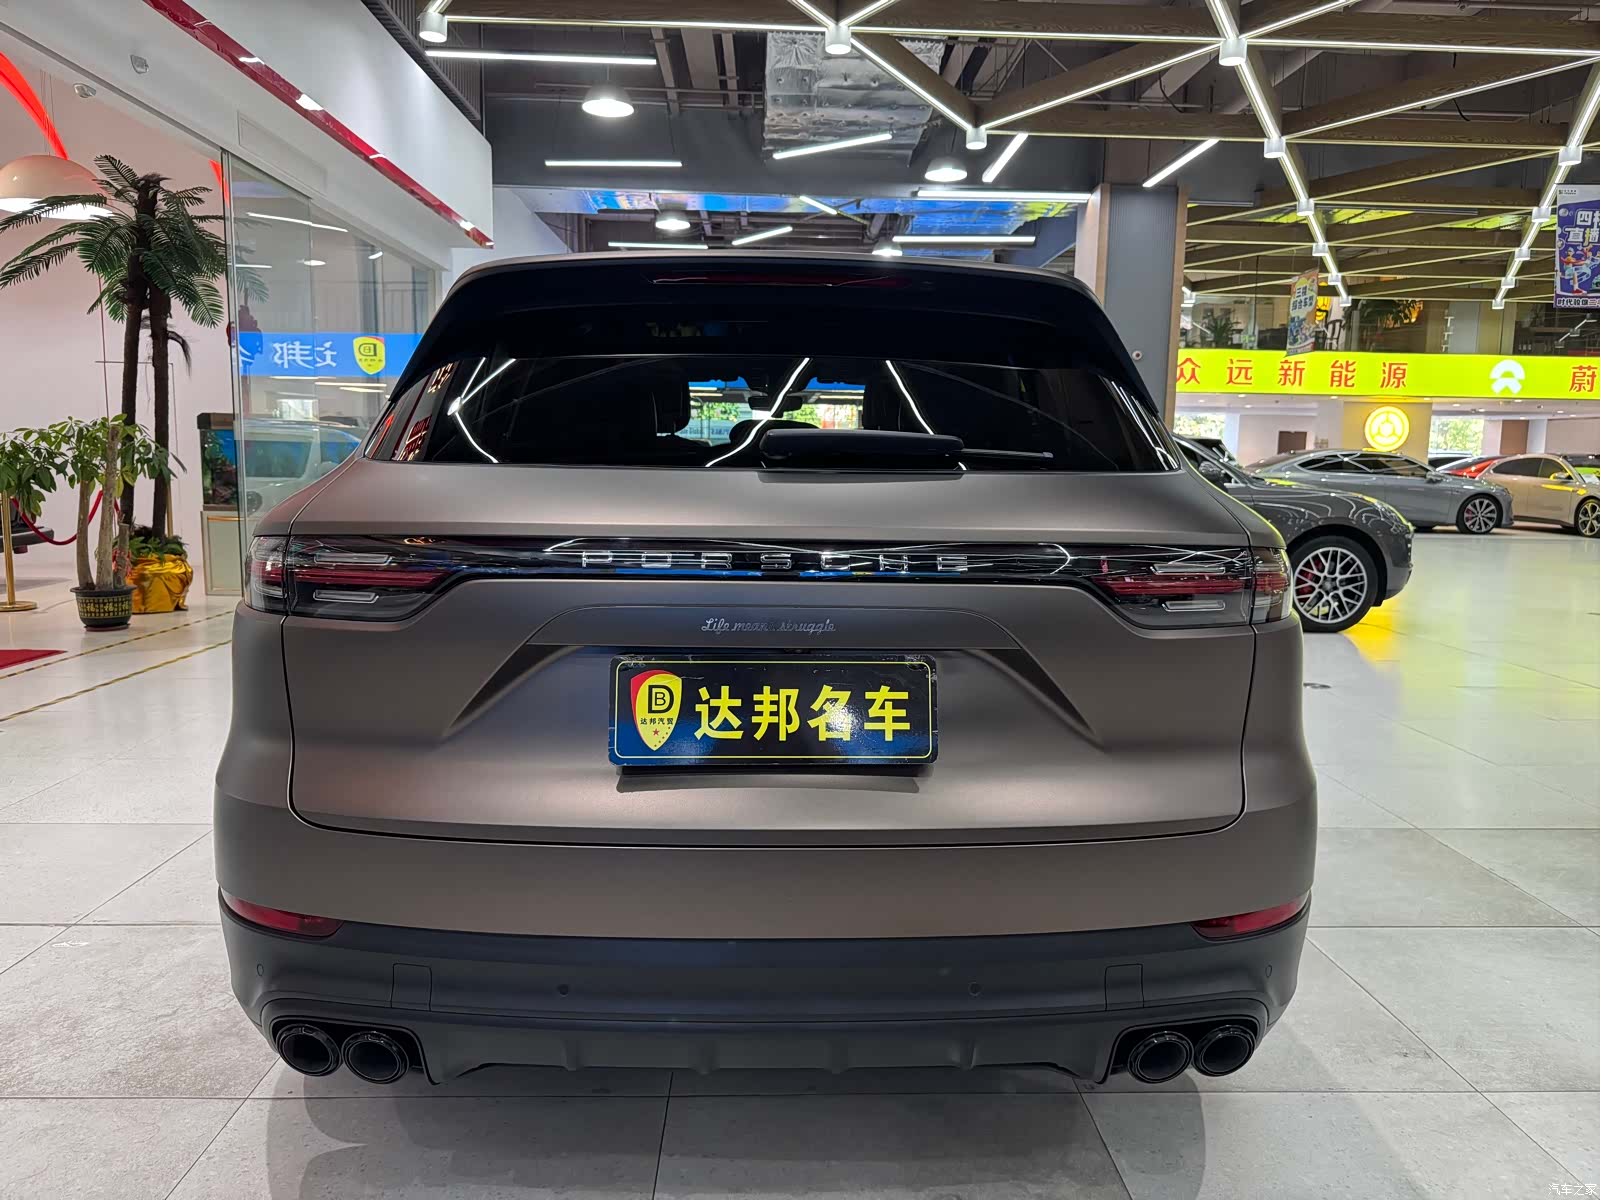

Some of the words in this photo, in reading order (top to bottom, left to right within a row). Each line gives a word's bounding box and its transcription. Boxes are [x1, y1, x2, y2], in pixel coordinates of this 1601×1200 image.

[1176, 358, 1408, 388] 众远新能源
[1568, 365, 1598, 392] 蔚
[581, 551, 968, 571] PORSCHE
[701, 618, 730, 634] Life
[731, 622, 776, 631] mean
[693, 685, 911, 742] 达邦名车
